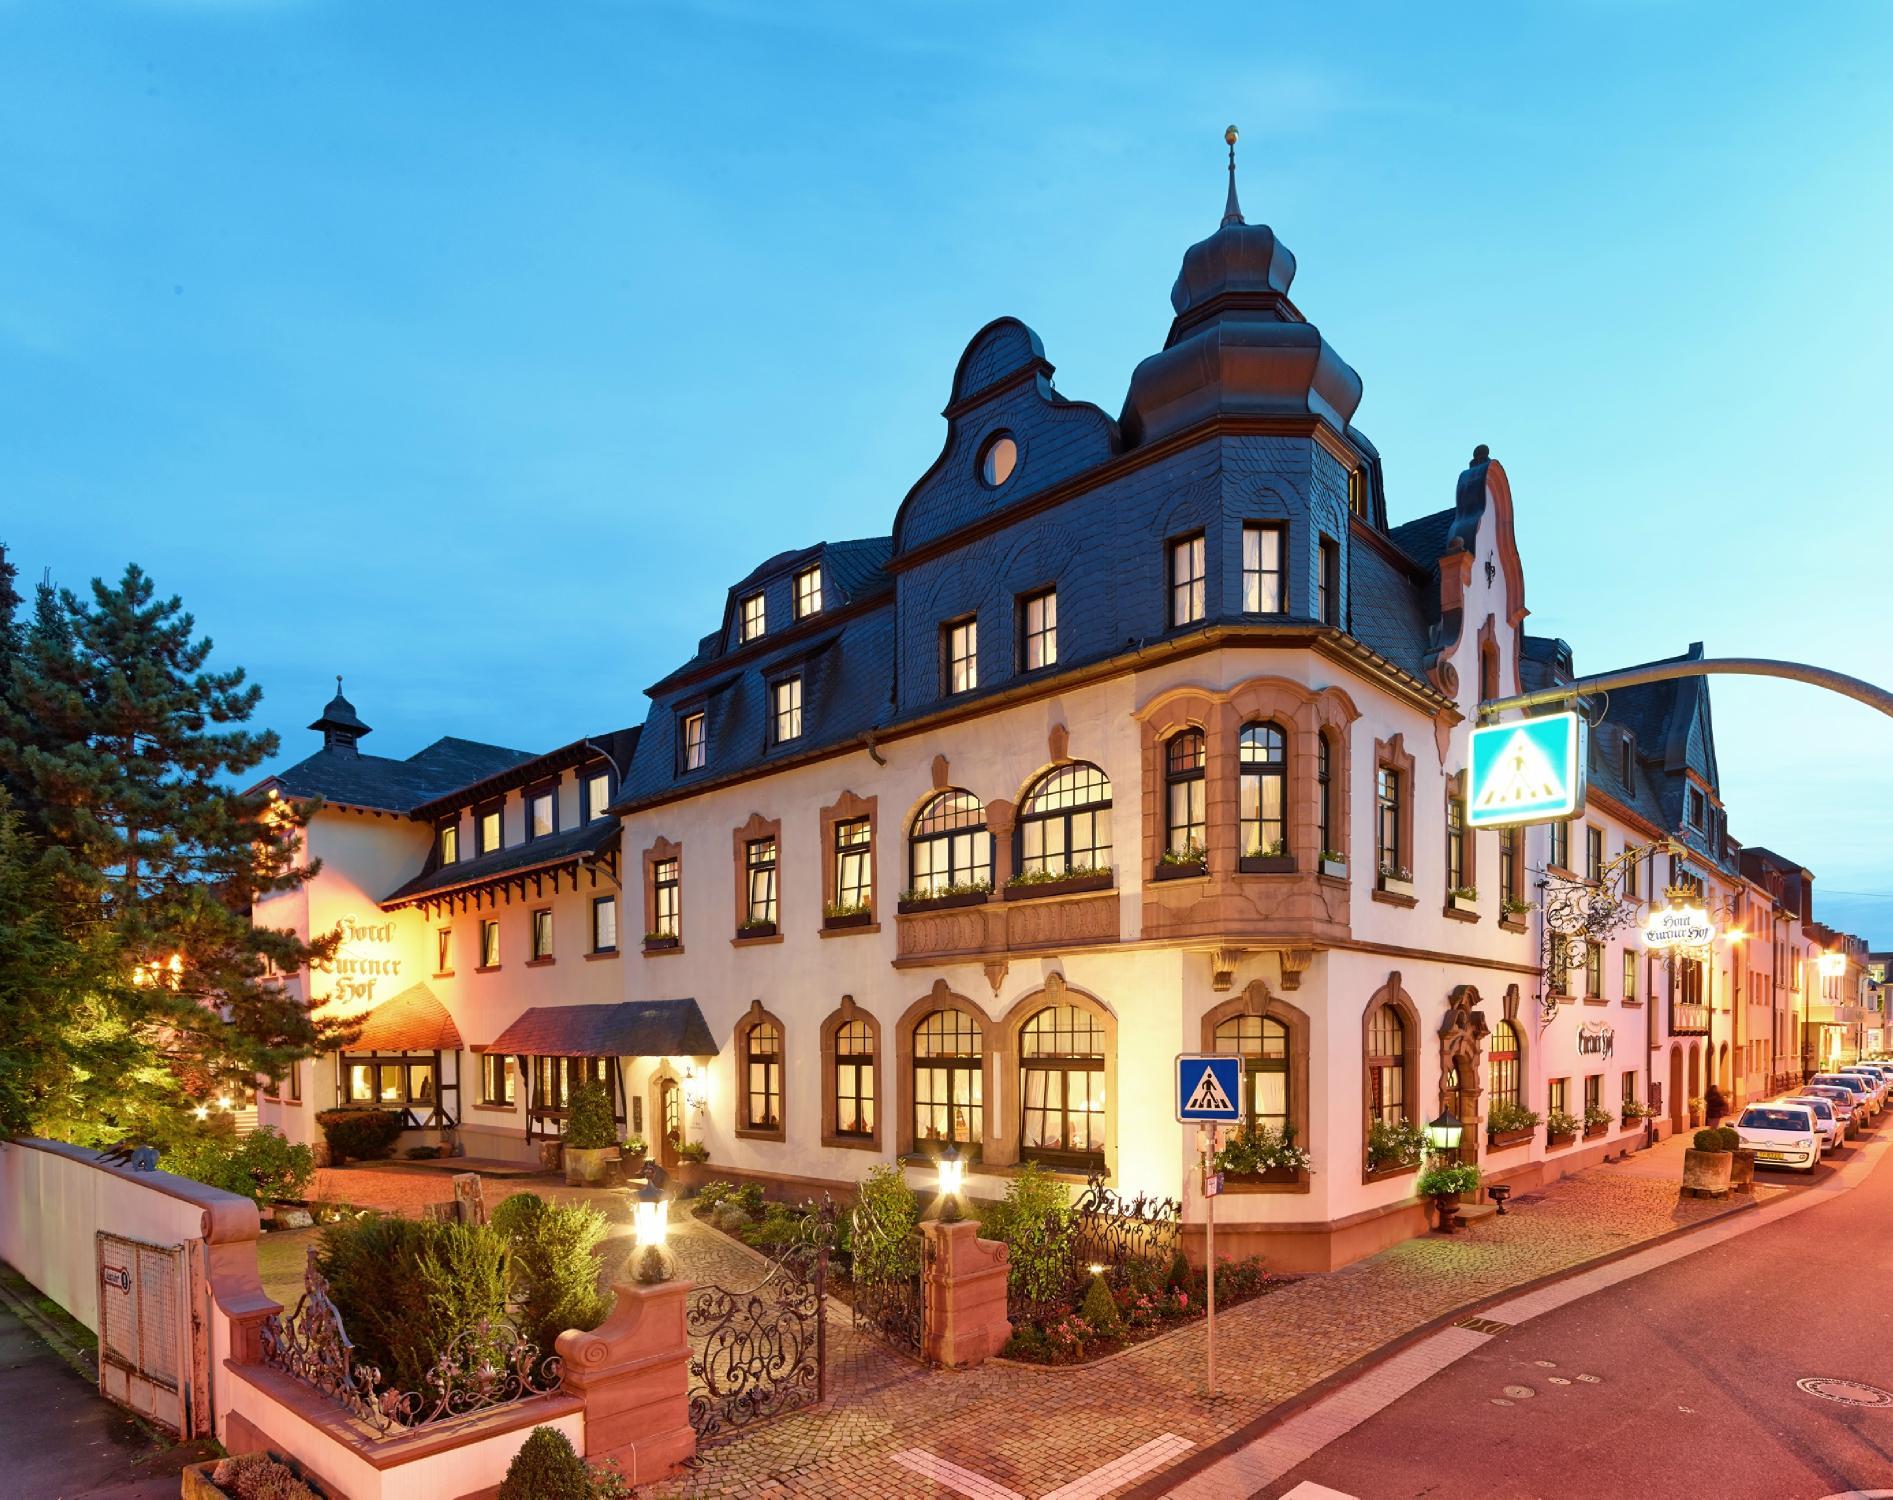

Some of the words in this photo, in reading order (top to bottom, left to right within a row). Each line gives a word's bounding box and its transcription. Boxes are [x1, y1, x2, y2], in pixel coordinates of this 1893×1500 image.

[1663, 914, 1691, 928] Hotel
[1687, 925, 1709, 941] Hof
[335, 976, 378, 1004] Hof
